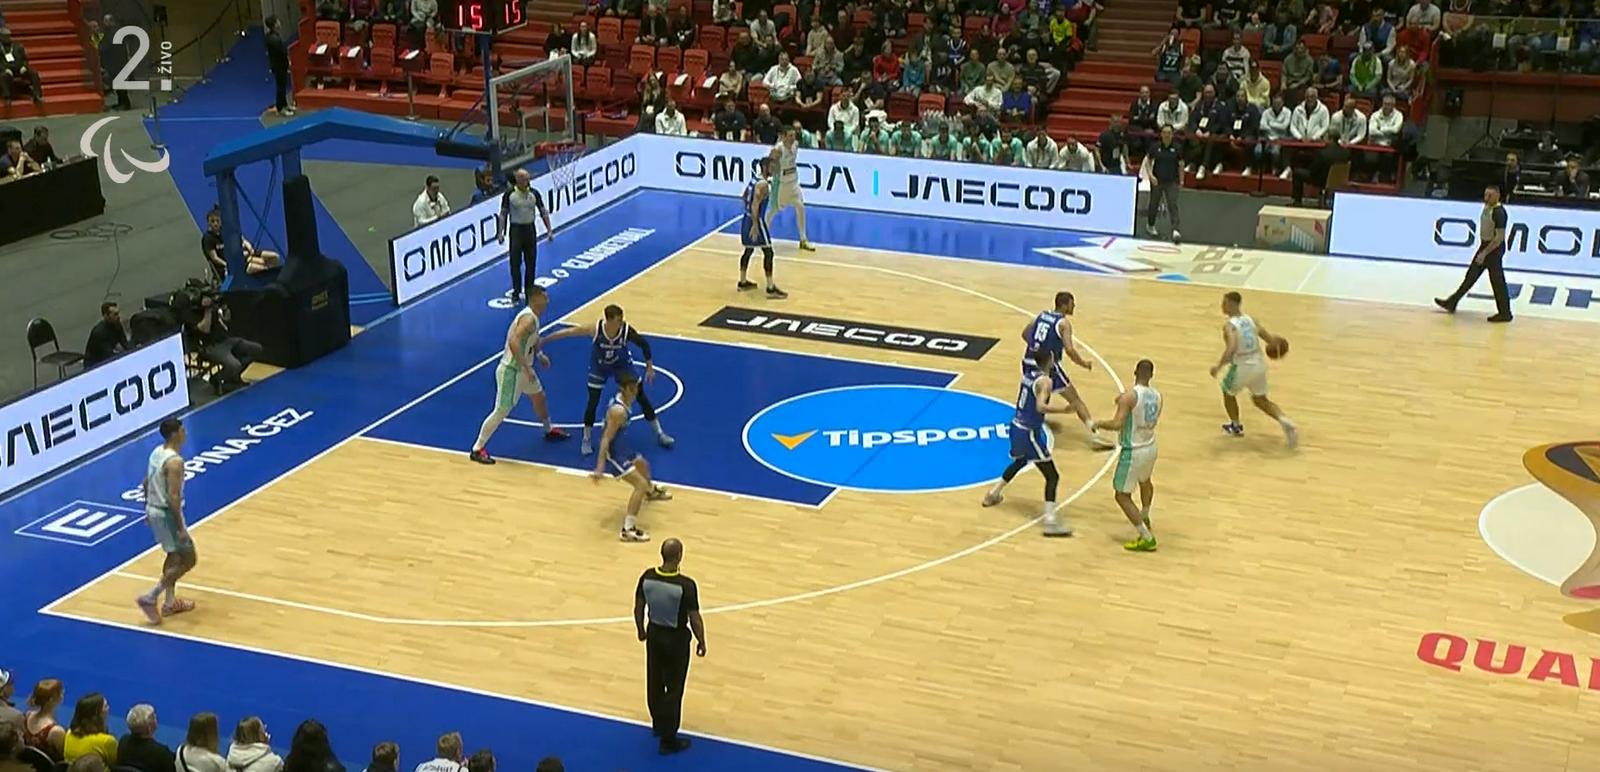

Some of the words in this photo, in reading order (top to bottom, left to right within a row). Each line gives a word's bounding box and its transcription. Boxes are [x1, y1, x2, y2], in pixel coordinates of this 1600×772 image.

[458, 4, 483, 29] 15
[505, 0, 521, 24] 15
[675, 151, 856, 194] OMDA
[890, 174, 1092, 215] JAECOO
[403, 212, 505, 282] OMOD
[726, 315, 969, 352] JAECOO
[1034, 321, 1050, 342] 15
[0, 360, 178, 468] AECOO
[240, 408, 314, 437] ČEZ
[823, 423, 1010, 448] Tipsport
